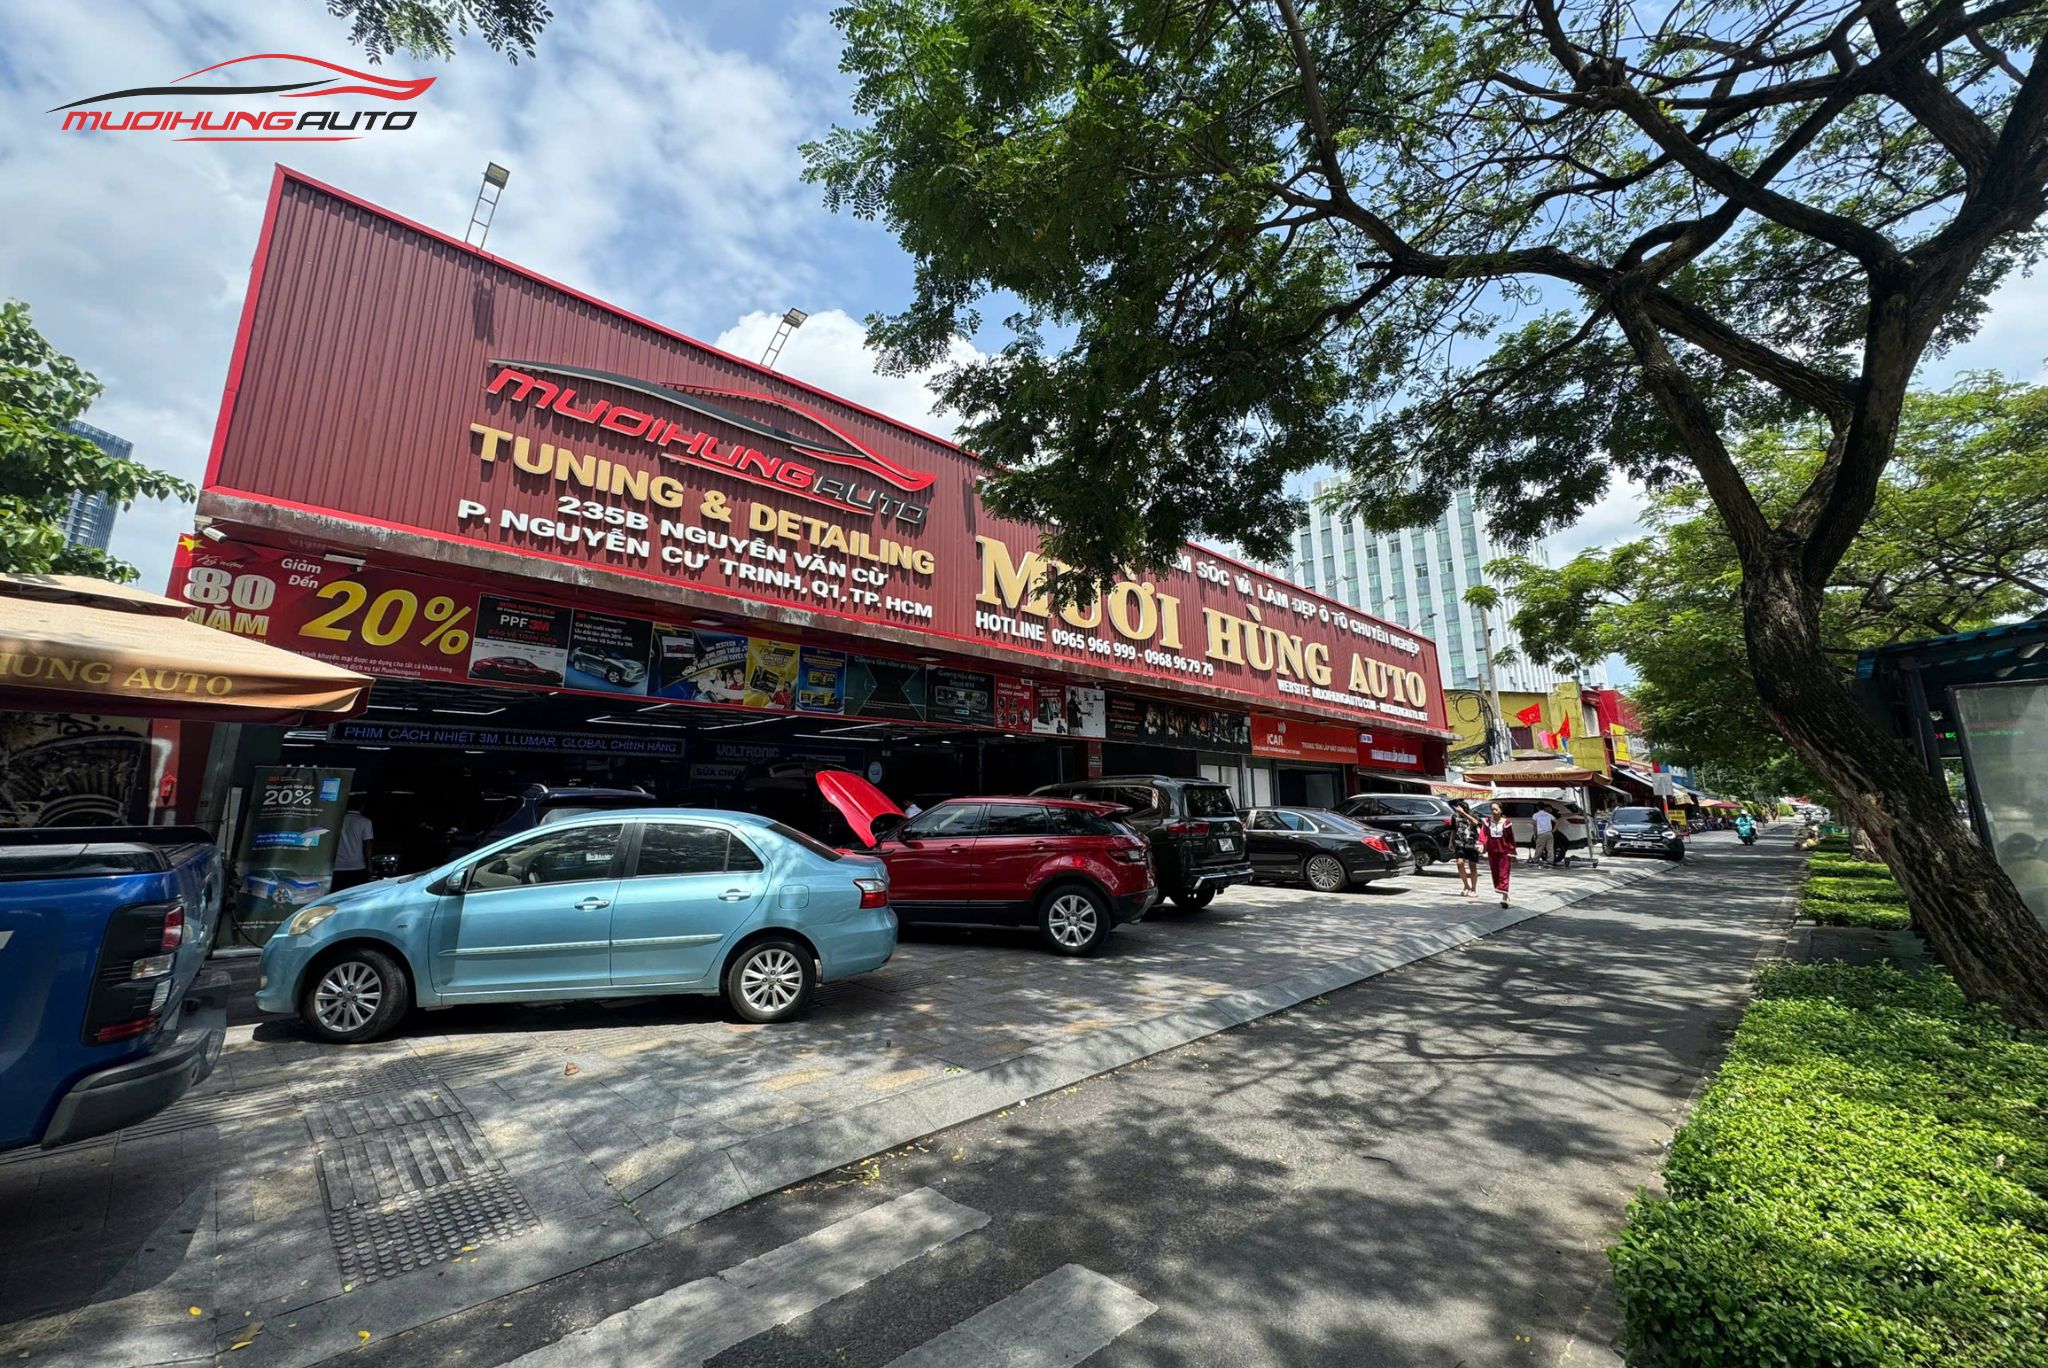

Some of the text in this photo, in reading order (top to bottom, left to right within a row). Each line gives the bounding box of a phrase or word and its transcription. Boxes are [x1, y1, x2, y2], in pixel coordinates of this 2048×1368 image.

[470, 422, 936, 575] TUNING & DETAILING
[457, 499, 491, 524] P.
[500, 509, 650, 558] NGUYỄN
[661, 546, 710, 569] CƯ
[719, 558, 808, 594] TRINH,
[885, 595, 933, 618] HCM
[557, 495, 889, 587] 235B NGUYỄN VĂN CỪ
[183, 566, 276, 610] 80
[281, 558, 322, 589] Giảm Đến
[298, 580, 473, 655] 20%
[500, 614, 529, 628] PPF
[1196, 560, 1230, 586] SÓC
[1234, 573, 1254, 597] VÀ
[1257, 583, 1288, 608] LÀM
[1291, 597, 1316, 619] ĐẸP
[1318, 605, 1329, 623] Ô
[1331, 611, 1347, 629] TÔ
[1350, 619, 1389, 645] CHUYÊN
[1052, 628, 1085, 650] 0965
[1087, 636, 1111, 655] 966
[1113, 641, 1136, 660] 999
[1144, 648, 1172, 668] 0968
[1202, 603, 1333, 686] HÙNG
[1348, 652, 1427, 708] AUTO
[122, 666, 233, 696] AUTO
[1276, 678, 1311, 697] WEBSITE
[344, 726, 384, 739] PHIM
[562, 737, 607, 749] GLOBAL
[716, 743, 780, 758] VOLTRONIC
[262, 789, 314, 806] 20%
